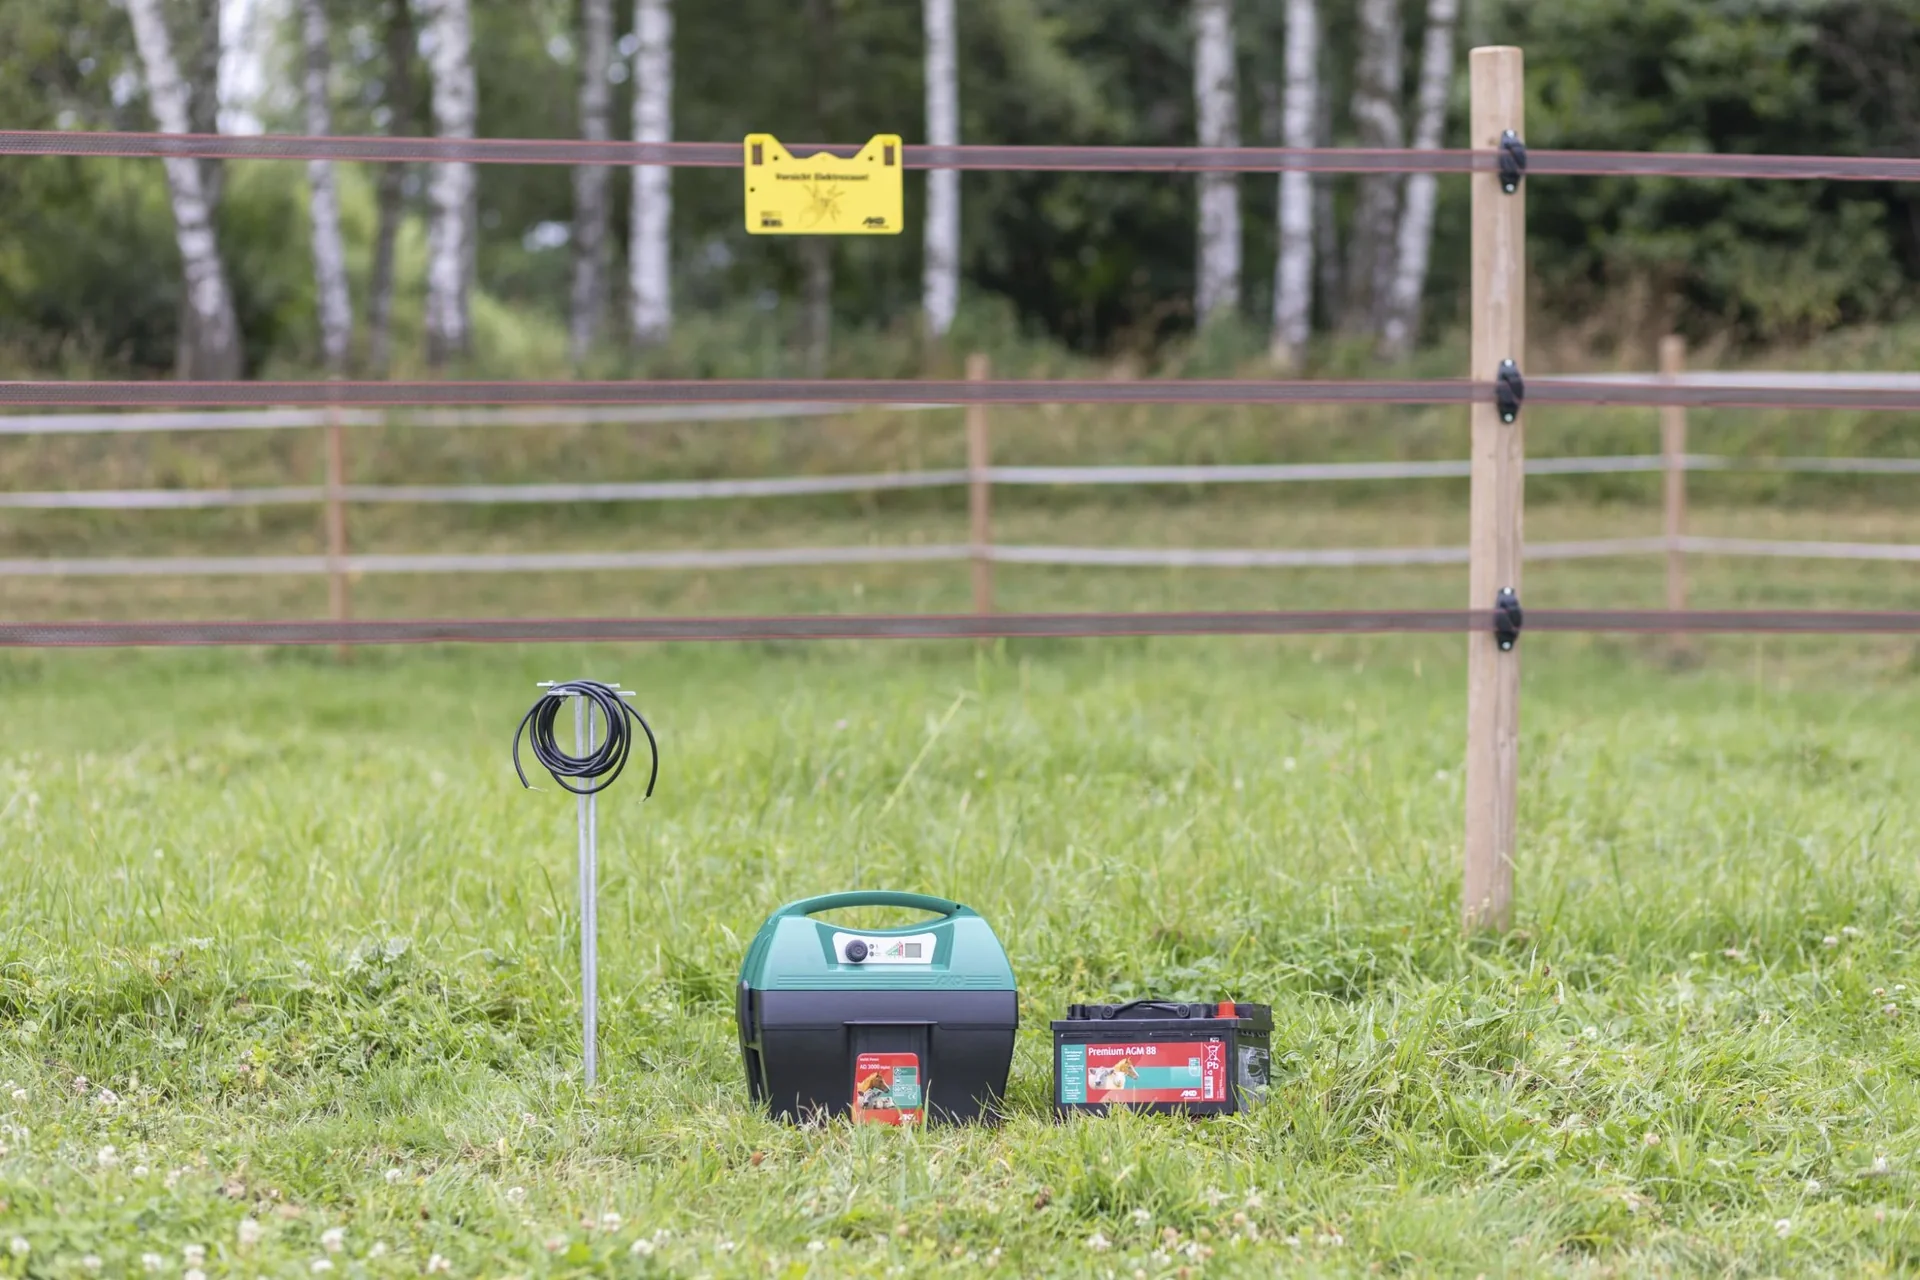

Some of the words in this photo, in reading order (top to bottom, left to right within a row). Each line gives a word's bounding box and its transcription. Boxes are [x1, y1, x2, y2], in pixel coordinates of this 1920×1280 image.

[1088, 1047, 1124, 1056] Premium
[1125, 1047, 1145, 1055] AGM
[1146, 1046, 1157, 1055] 88
[1207, 1061, 1219, 1070] Pb
